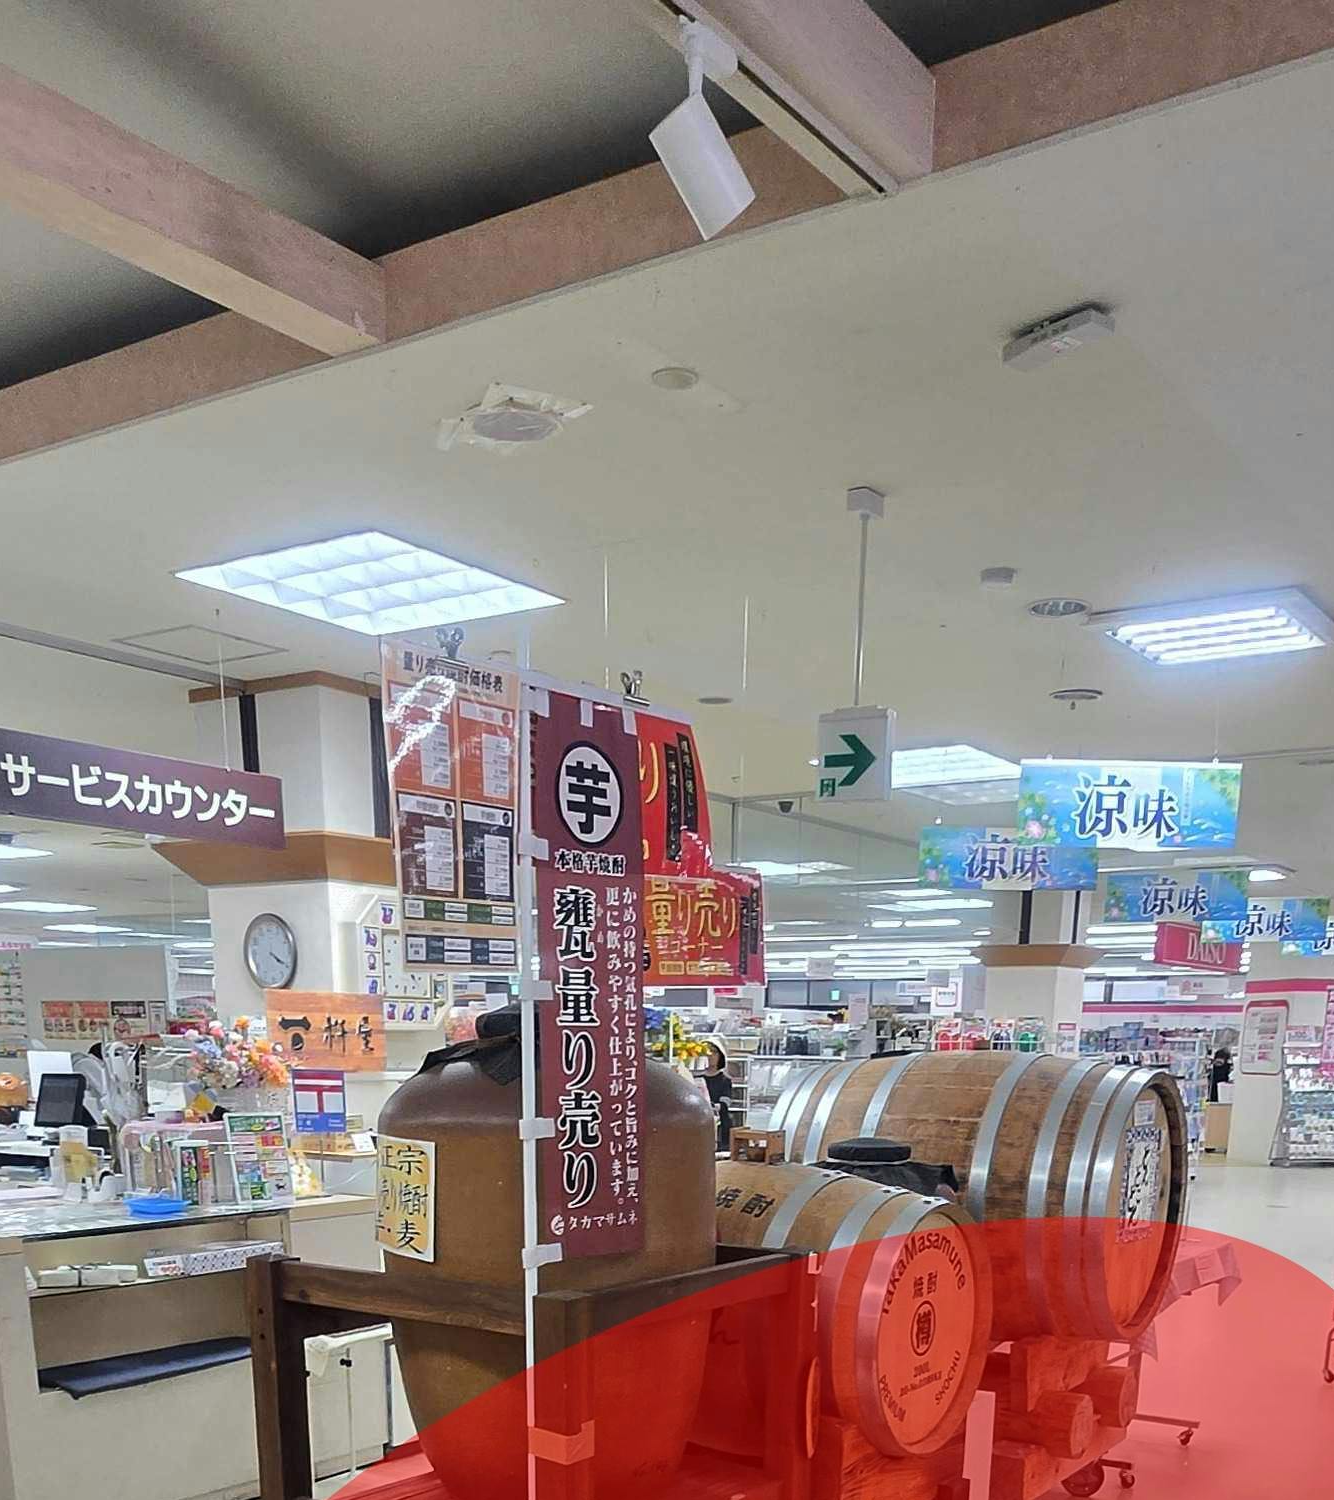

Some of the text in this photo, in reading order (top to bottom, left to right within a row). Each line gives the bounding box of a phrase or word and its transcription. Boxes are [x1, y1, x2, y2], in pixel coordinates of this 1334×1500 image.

[0, 752, 277, 828] サービスカウンター
[565, 761, 612, 835] 芋
[1072, 771, 1181, 842] 涼味
[554, 848, 626, 876] 本格芋焼酎
[964, 832, 1051, 884] 涼味
[645, 878, 736, 937] 量り売り
[1139, 877, 1210, 918] 涼味
[1235, 905, 1293, 937] 涼味
[1186, 932, 1227, 965] DAISO
[568, 1209, 638, 1232] タカマサムネ
[716, 1186, 776, 1218] 焼酎
[879, 1374, 907, 1422] PREMIUM
[935, 1350, 962, 1405] SHOCHU
